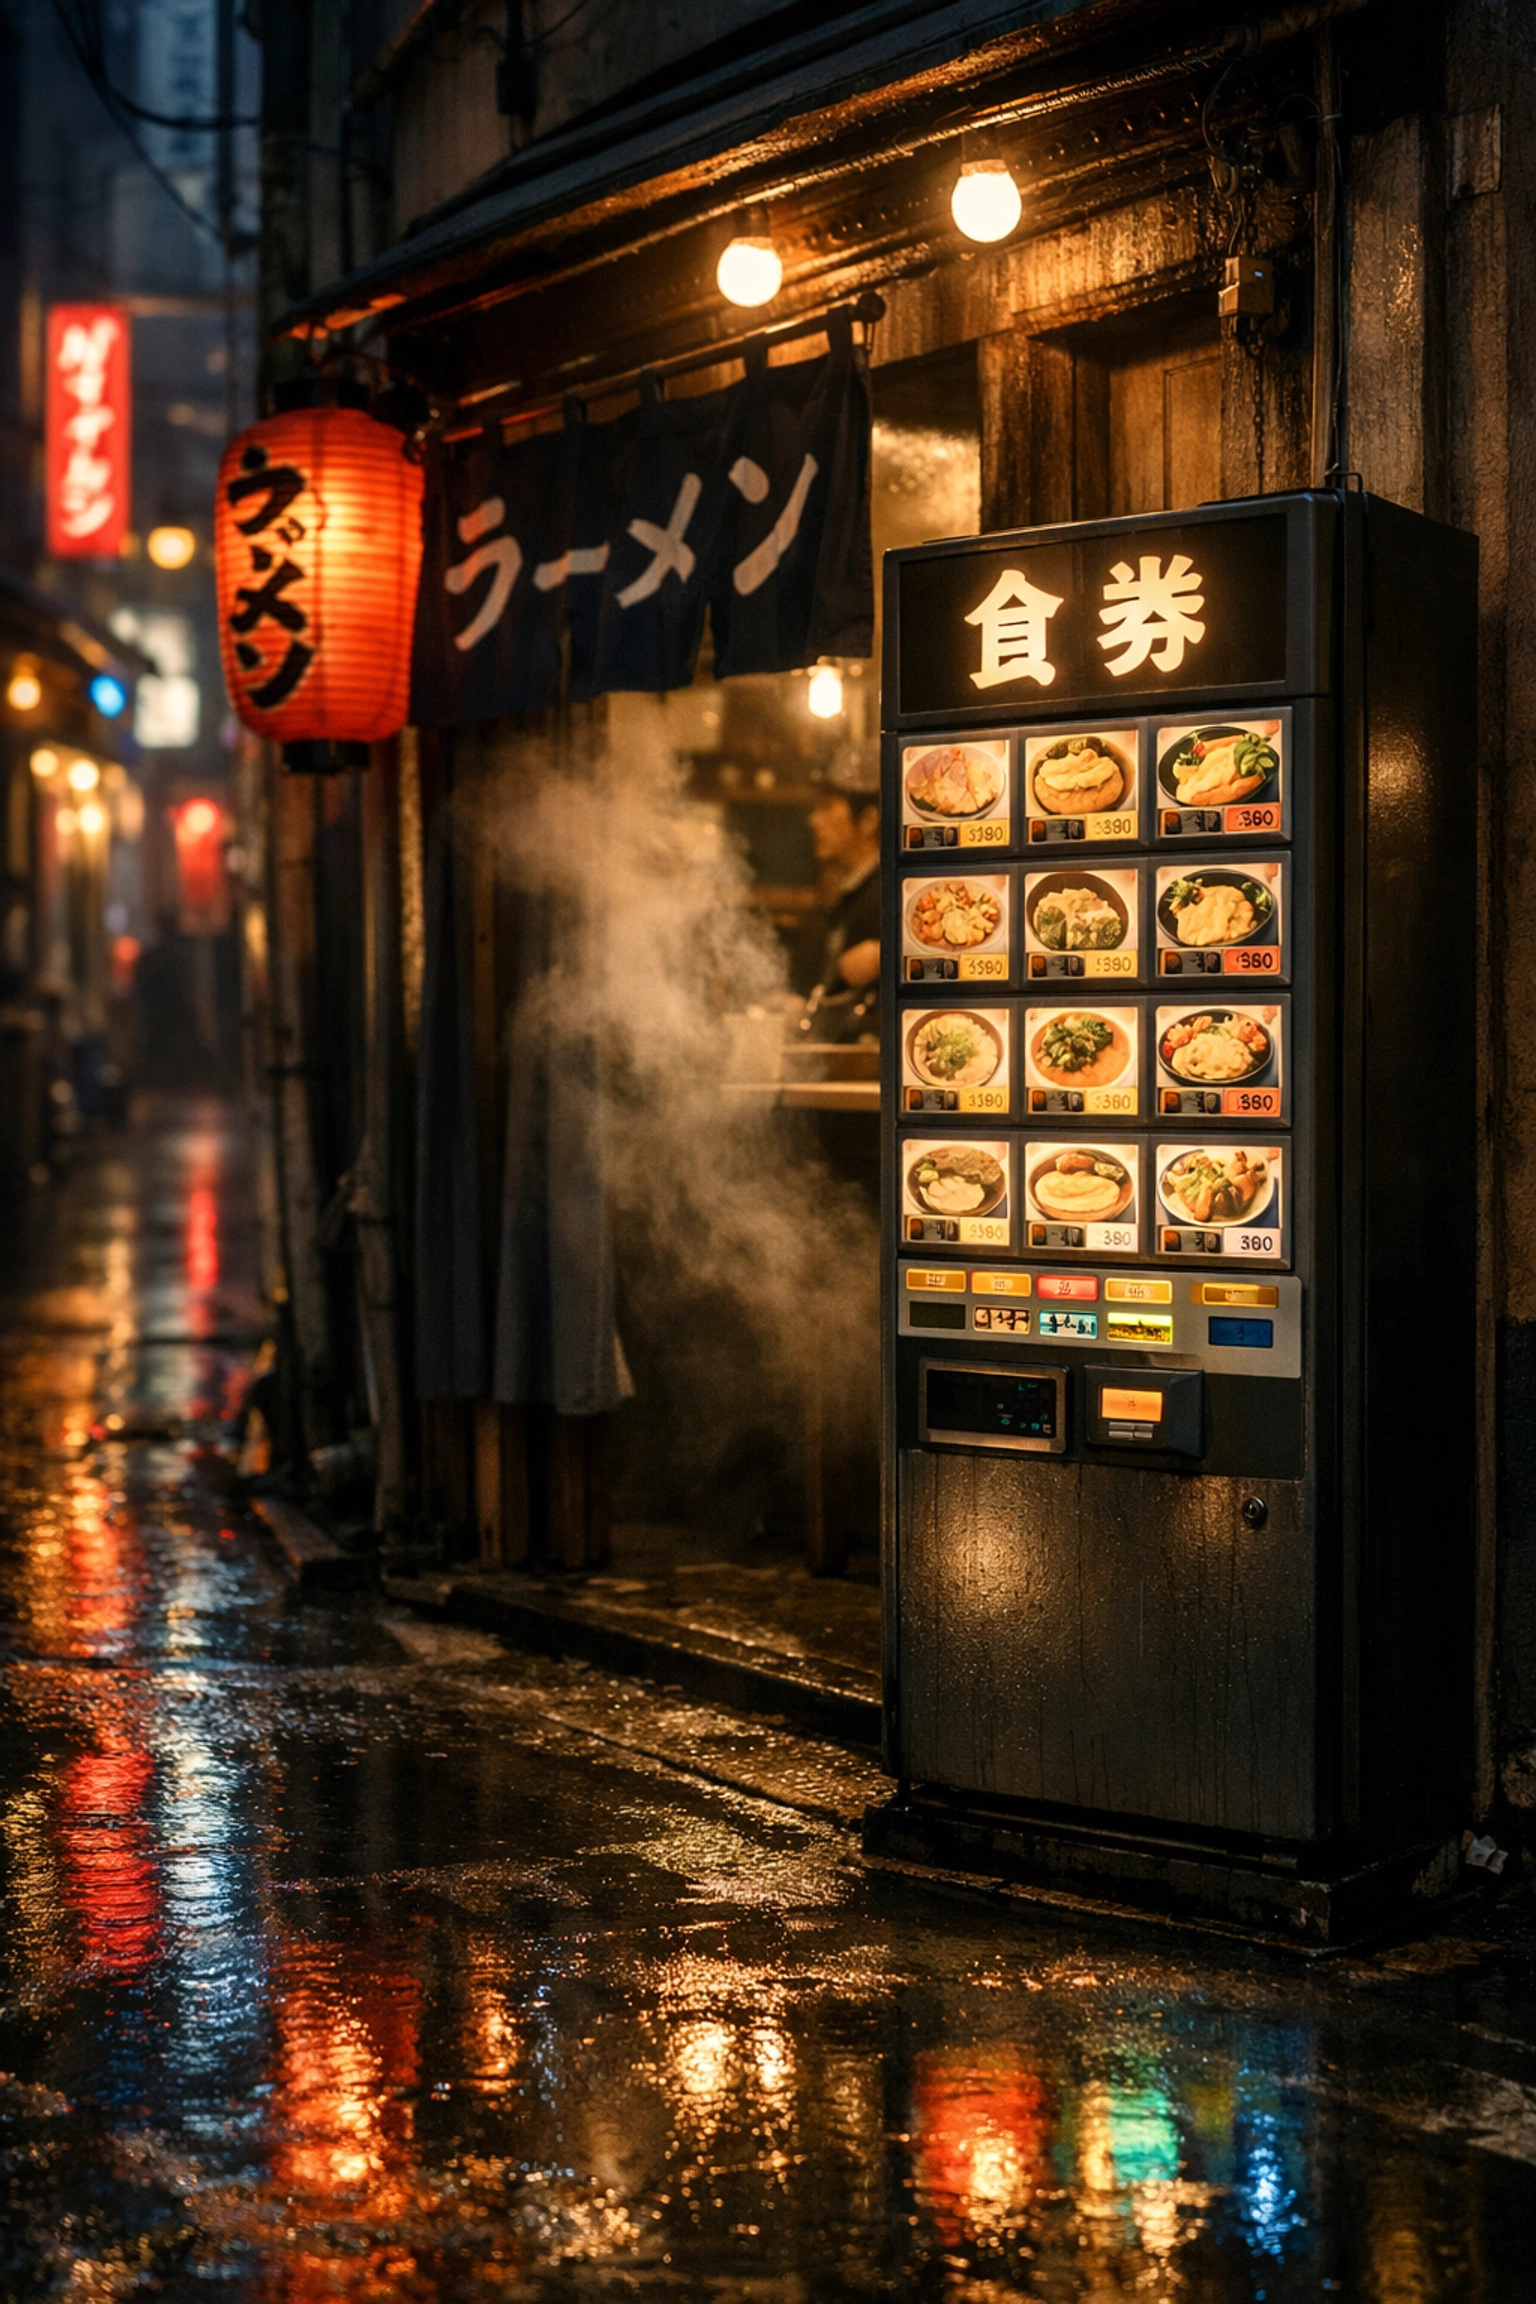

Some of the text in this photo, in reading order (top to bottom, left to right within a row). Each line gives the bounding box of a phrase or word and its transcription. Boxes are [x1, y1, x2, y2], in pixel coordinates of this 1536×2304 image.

[444, 452, 819, 652] ラーメン
[964, 554, 1206, 690] 食券
